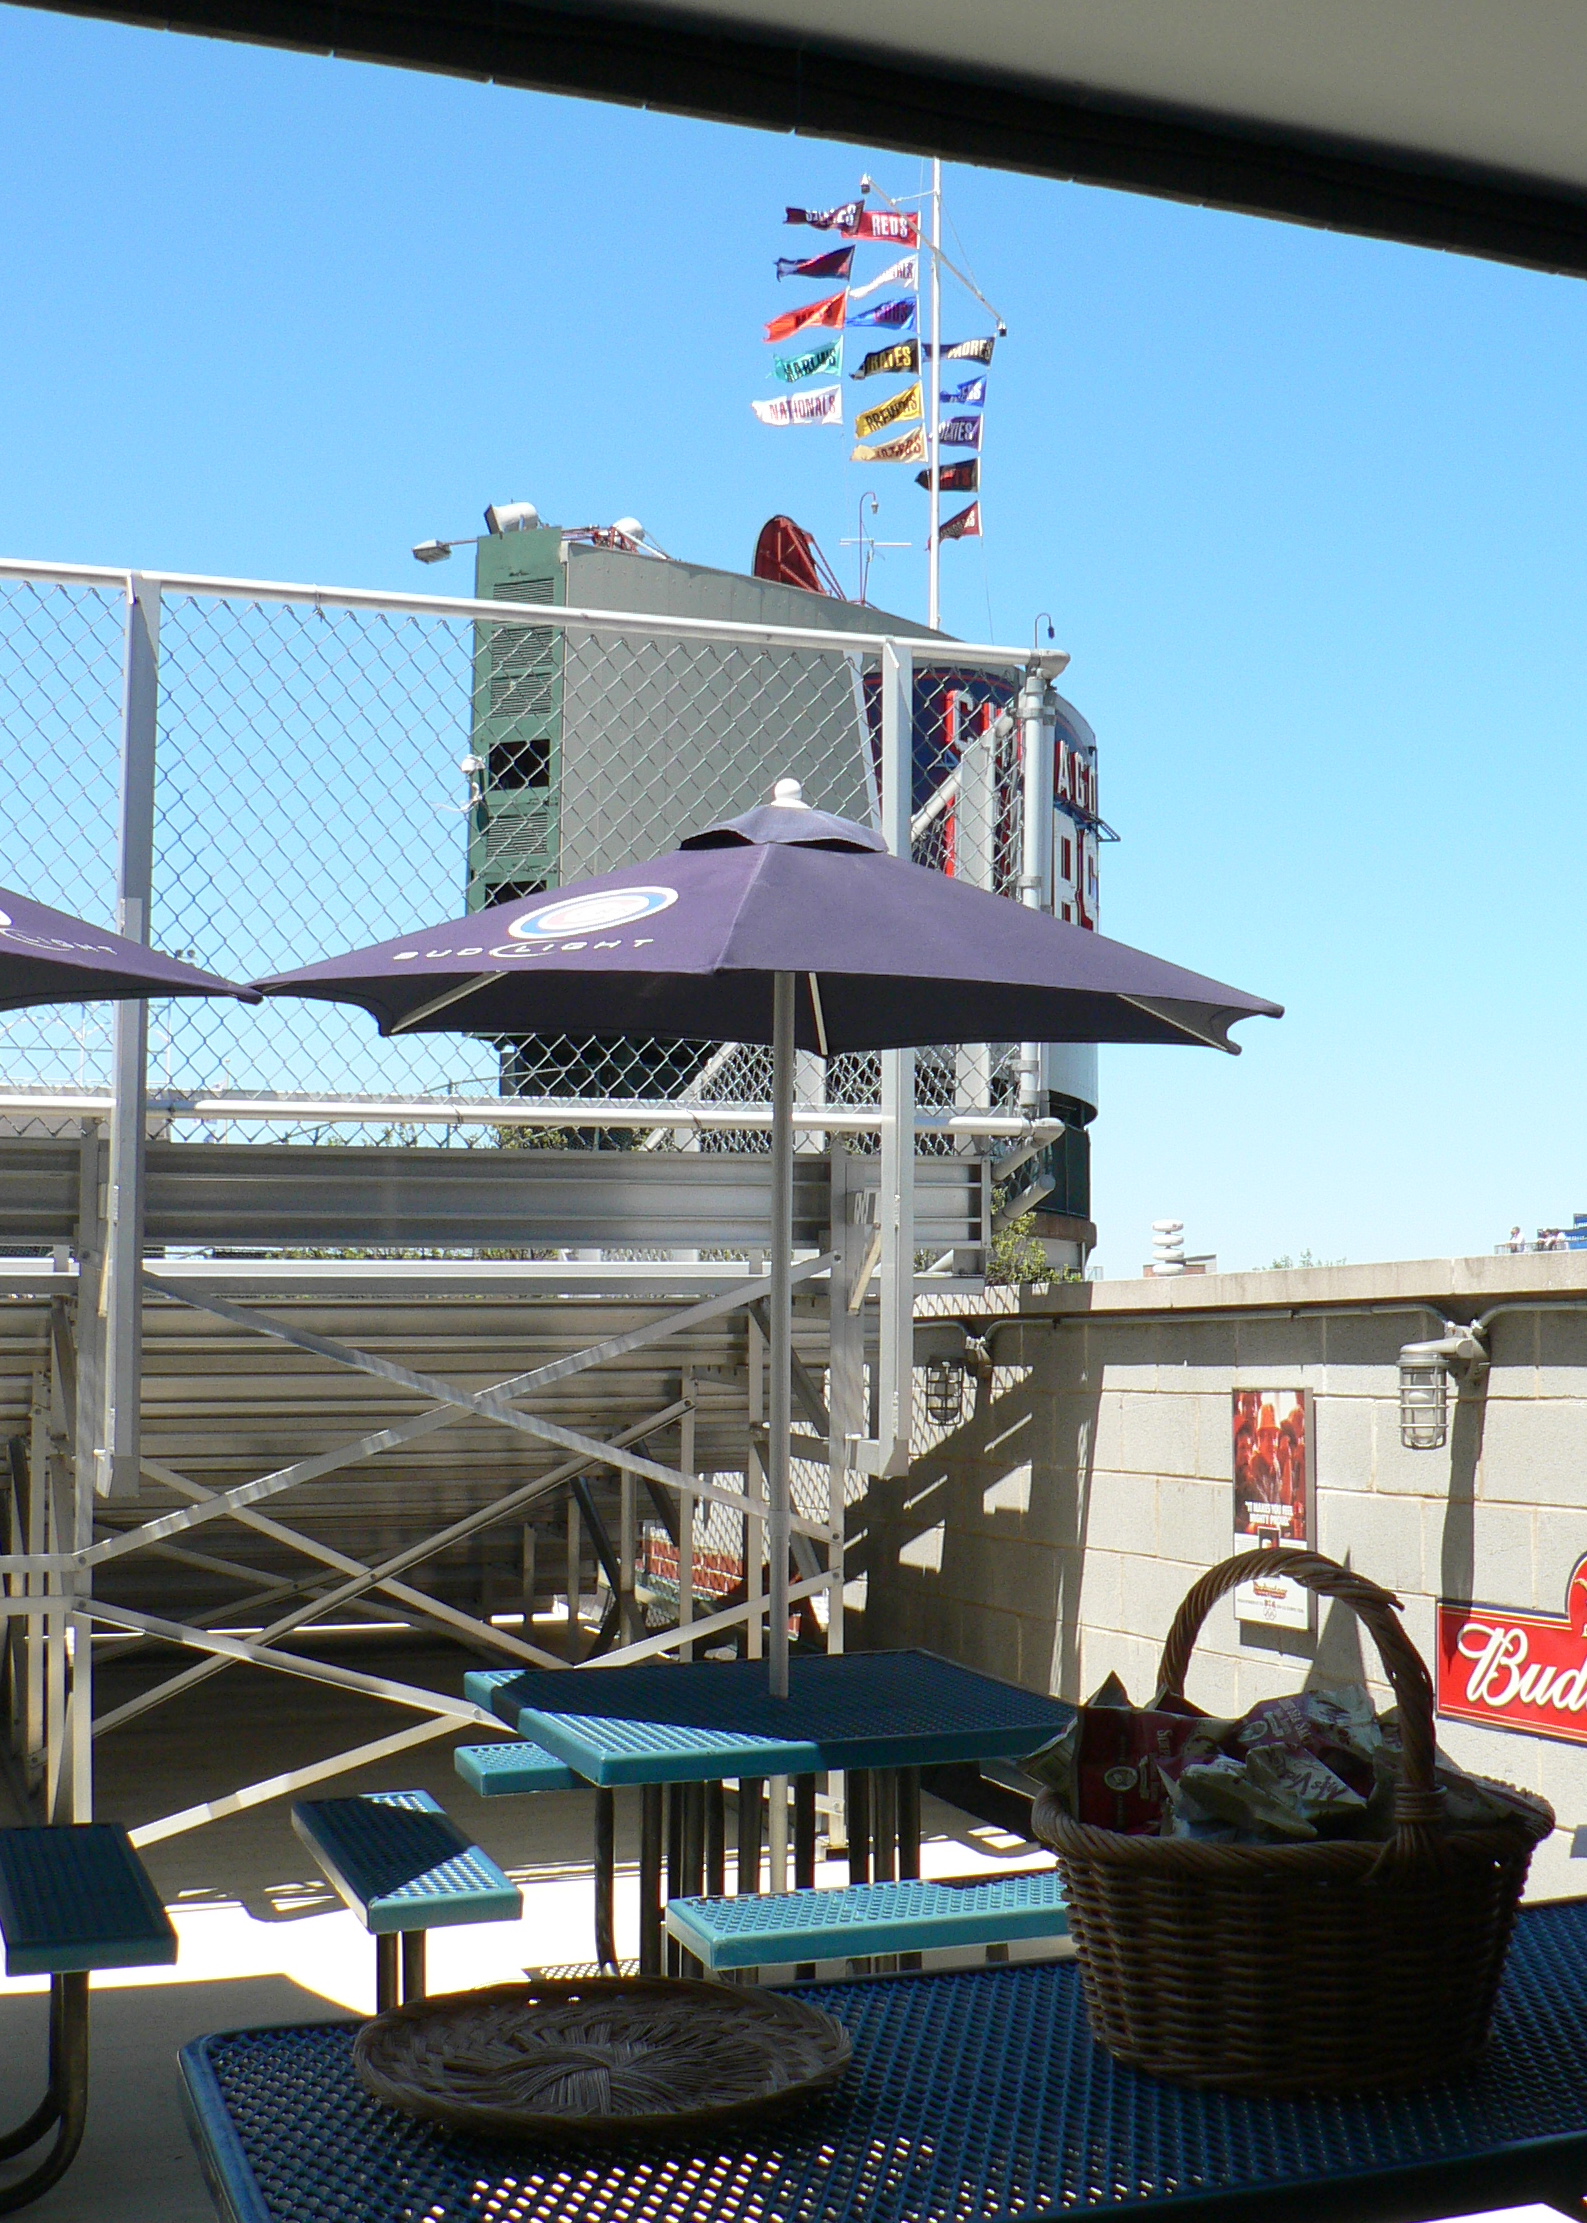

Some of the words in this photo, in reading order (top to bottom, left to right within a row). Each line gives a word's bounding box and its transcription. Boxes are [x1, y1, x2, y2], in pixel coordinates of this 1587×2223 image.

[871, 214, 908, 238] REDS
[866, 346, 912, 371] IRATES
[769, 395, 836, 420] NATIONALS
[393, 947, 484, 960] BUD
[513, 938, 654, 953] LIGHT
